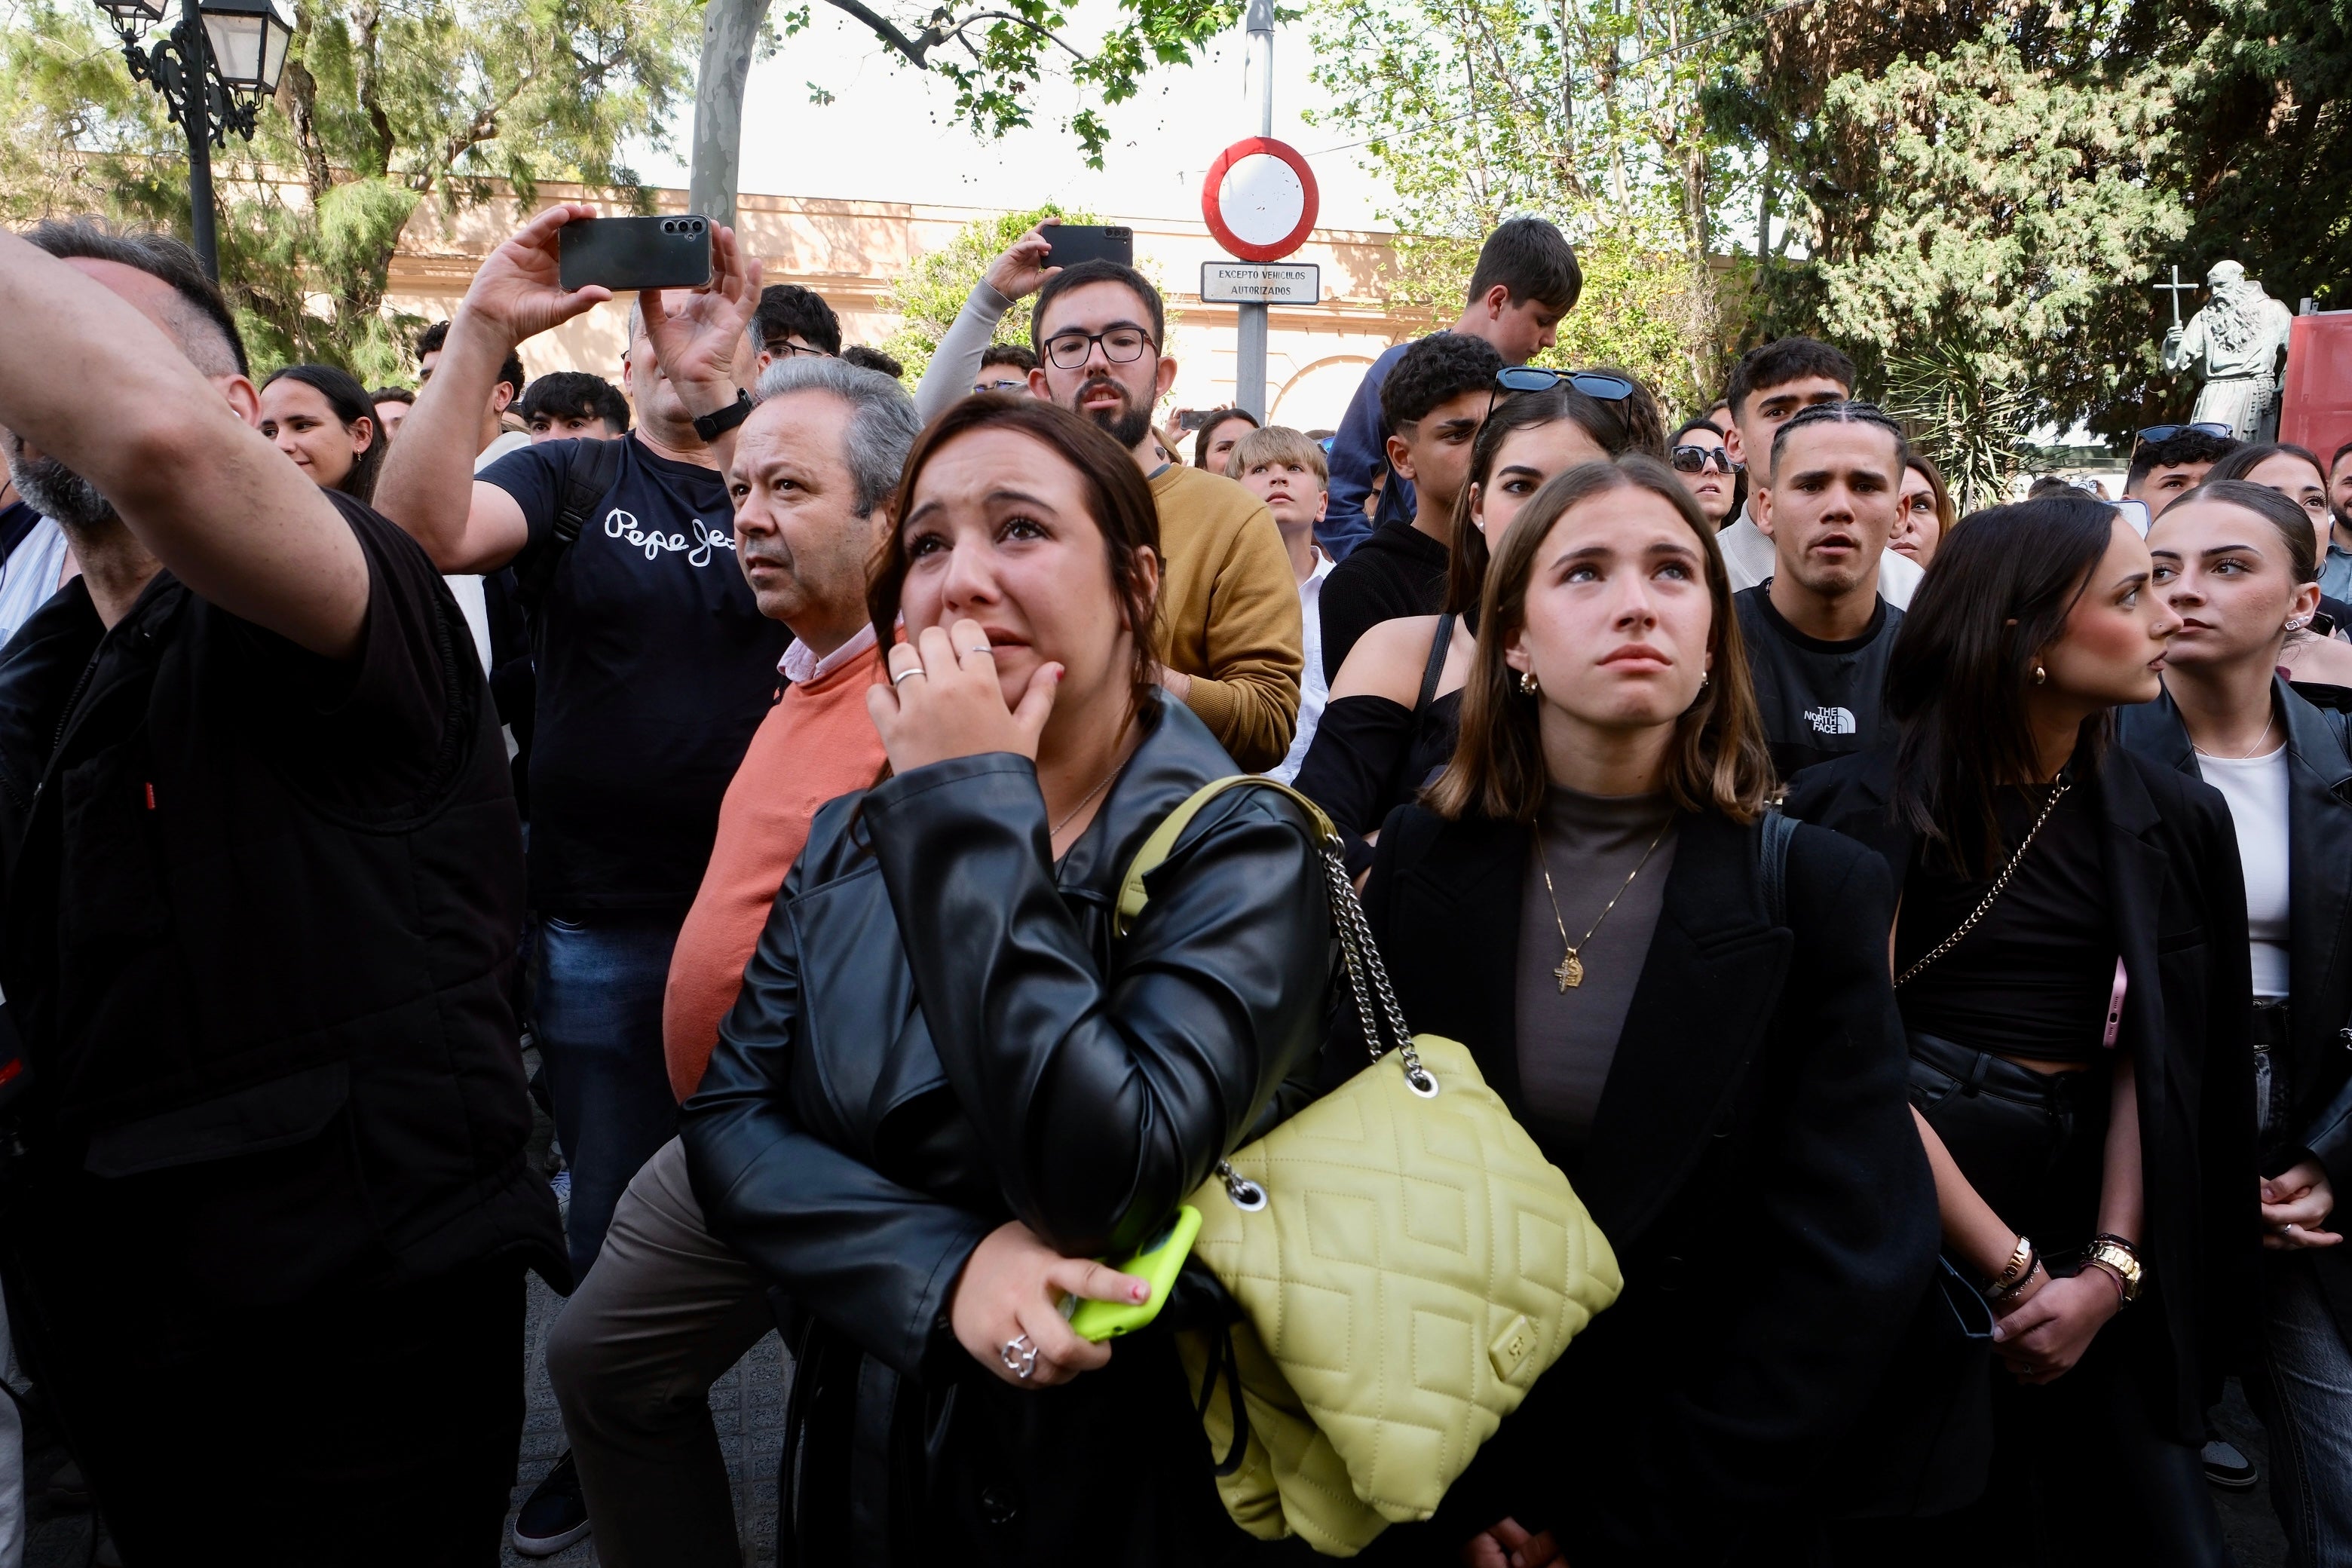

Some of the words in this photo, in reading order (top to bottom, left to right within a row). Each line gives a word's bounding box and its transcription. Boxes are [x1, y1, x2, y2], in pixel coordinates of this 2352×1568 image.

[1219, 270, 1259, 280] EXCEPTO
[1262, 271, 1306, 280] VEHICULOS
[1231, 286, 1291, 296] AUTORIZADOS
[605, 507, 690, 561] Pepe
[1817, 706, 1838, 716] THE
[1804, 710, 1837, 725] NORTH
[1812, 721, 1837, 734] FACE
